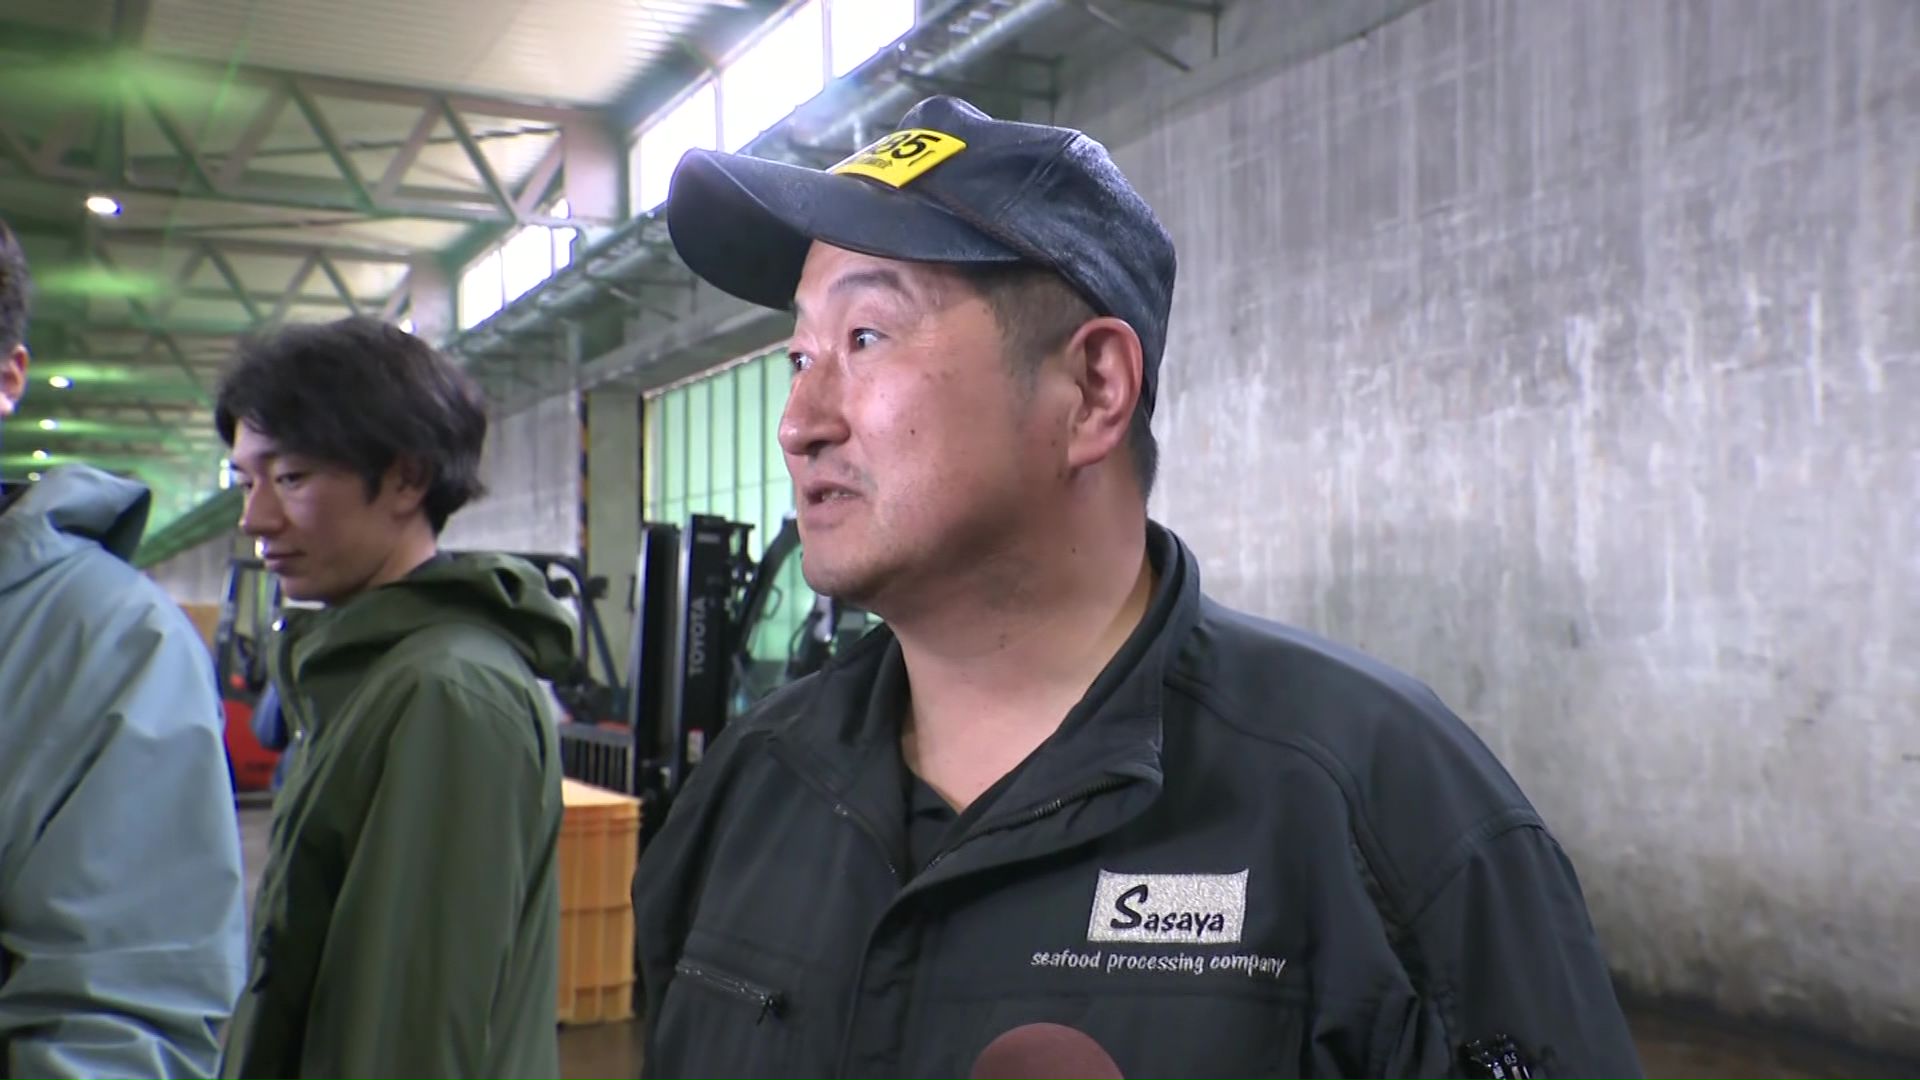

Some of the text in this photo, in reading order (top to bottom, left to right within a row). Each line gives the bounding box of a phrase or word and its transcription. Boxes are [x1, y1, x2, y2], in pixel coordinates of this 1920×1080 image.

[688, 597, 706, 677] TOYOTA
[1110, 884, 1225, 938] Sasaya
[1030, 948, 1287, 979] seafood processing company
